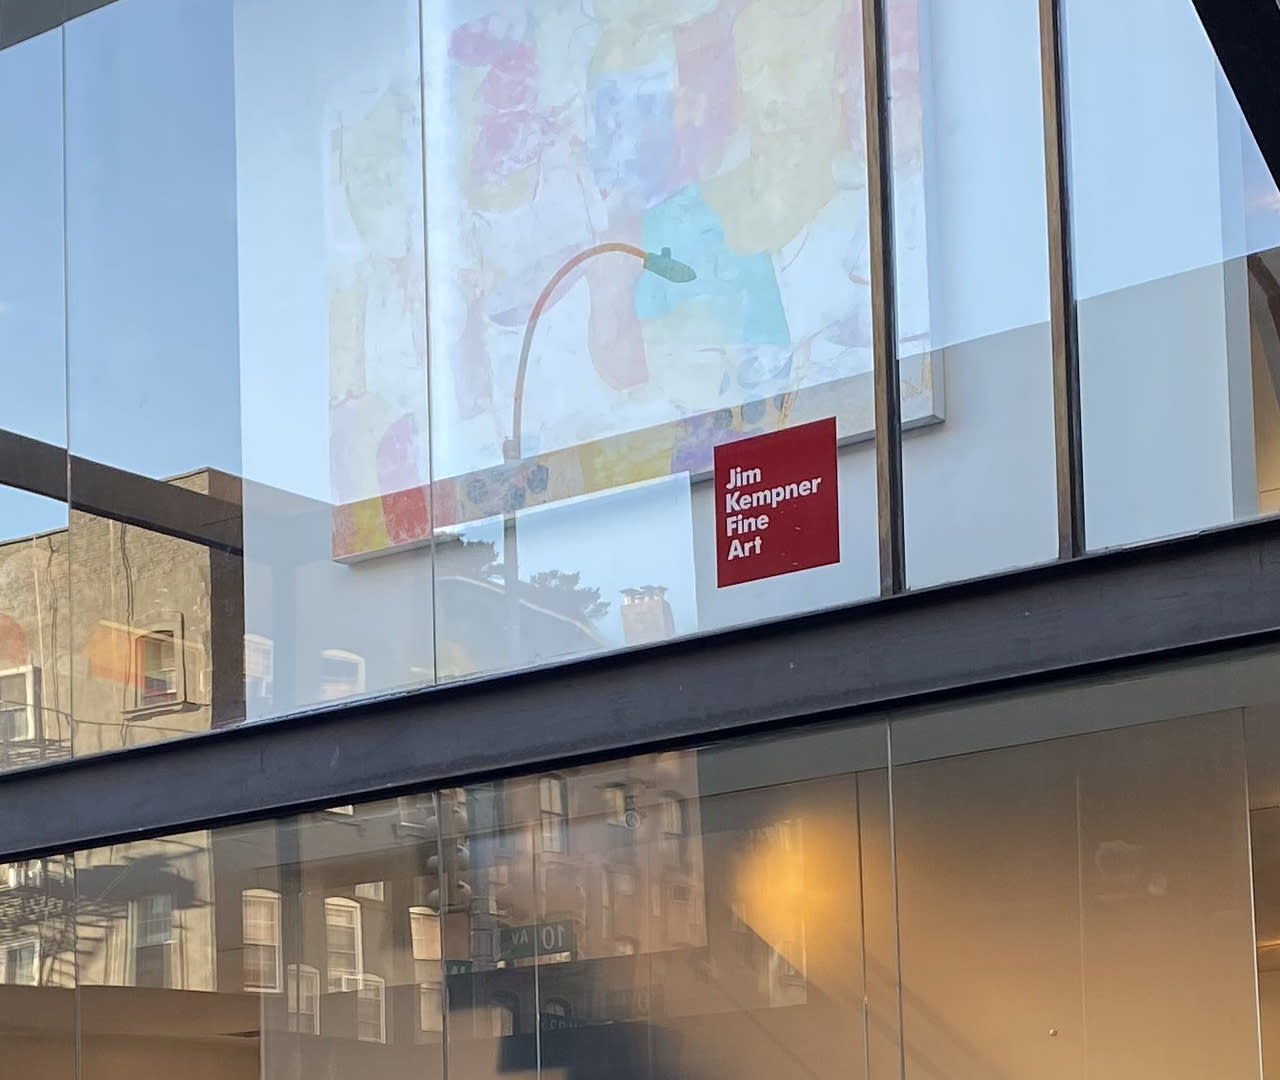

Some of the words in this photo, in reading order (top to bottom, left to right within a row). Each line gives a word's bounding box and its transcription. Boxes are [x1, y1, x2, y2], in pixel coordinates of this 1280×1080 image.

[726, 466, 762, 490] Jim
[725, 477, 822, 514] Kempner
[726, 514, 770, 537] Fine
[727, 536, 762, 561] Art
